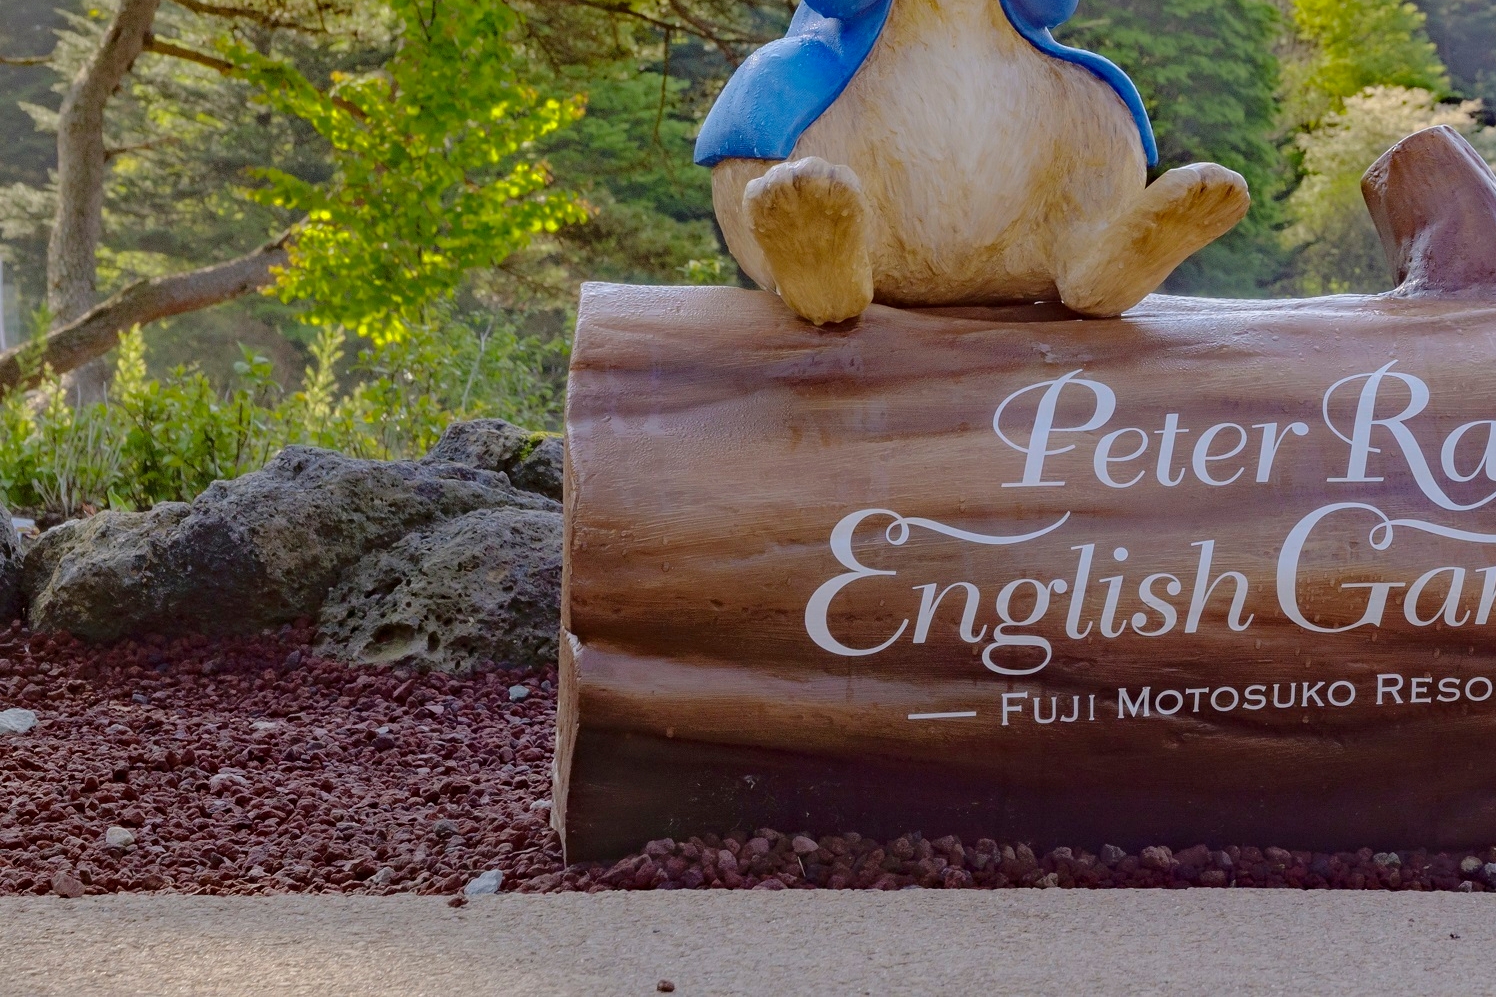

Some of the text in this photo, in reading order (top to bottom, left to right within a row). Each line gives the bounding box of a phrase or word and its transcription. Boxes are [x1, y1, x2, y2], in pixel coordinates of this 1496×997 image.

[992, 368, 1310, 489] Peter
[804, 508, 1255, 675] English
[1001, 691, 1097, 726] FUJI
[1117, 680, 1357, 719] MOTOSUKO
